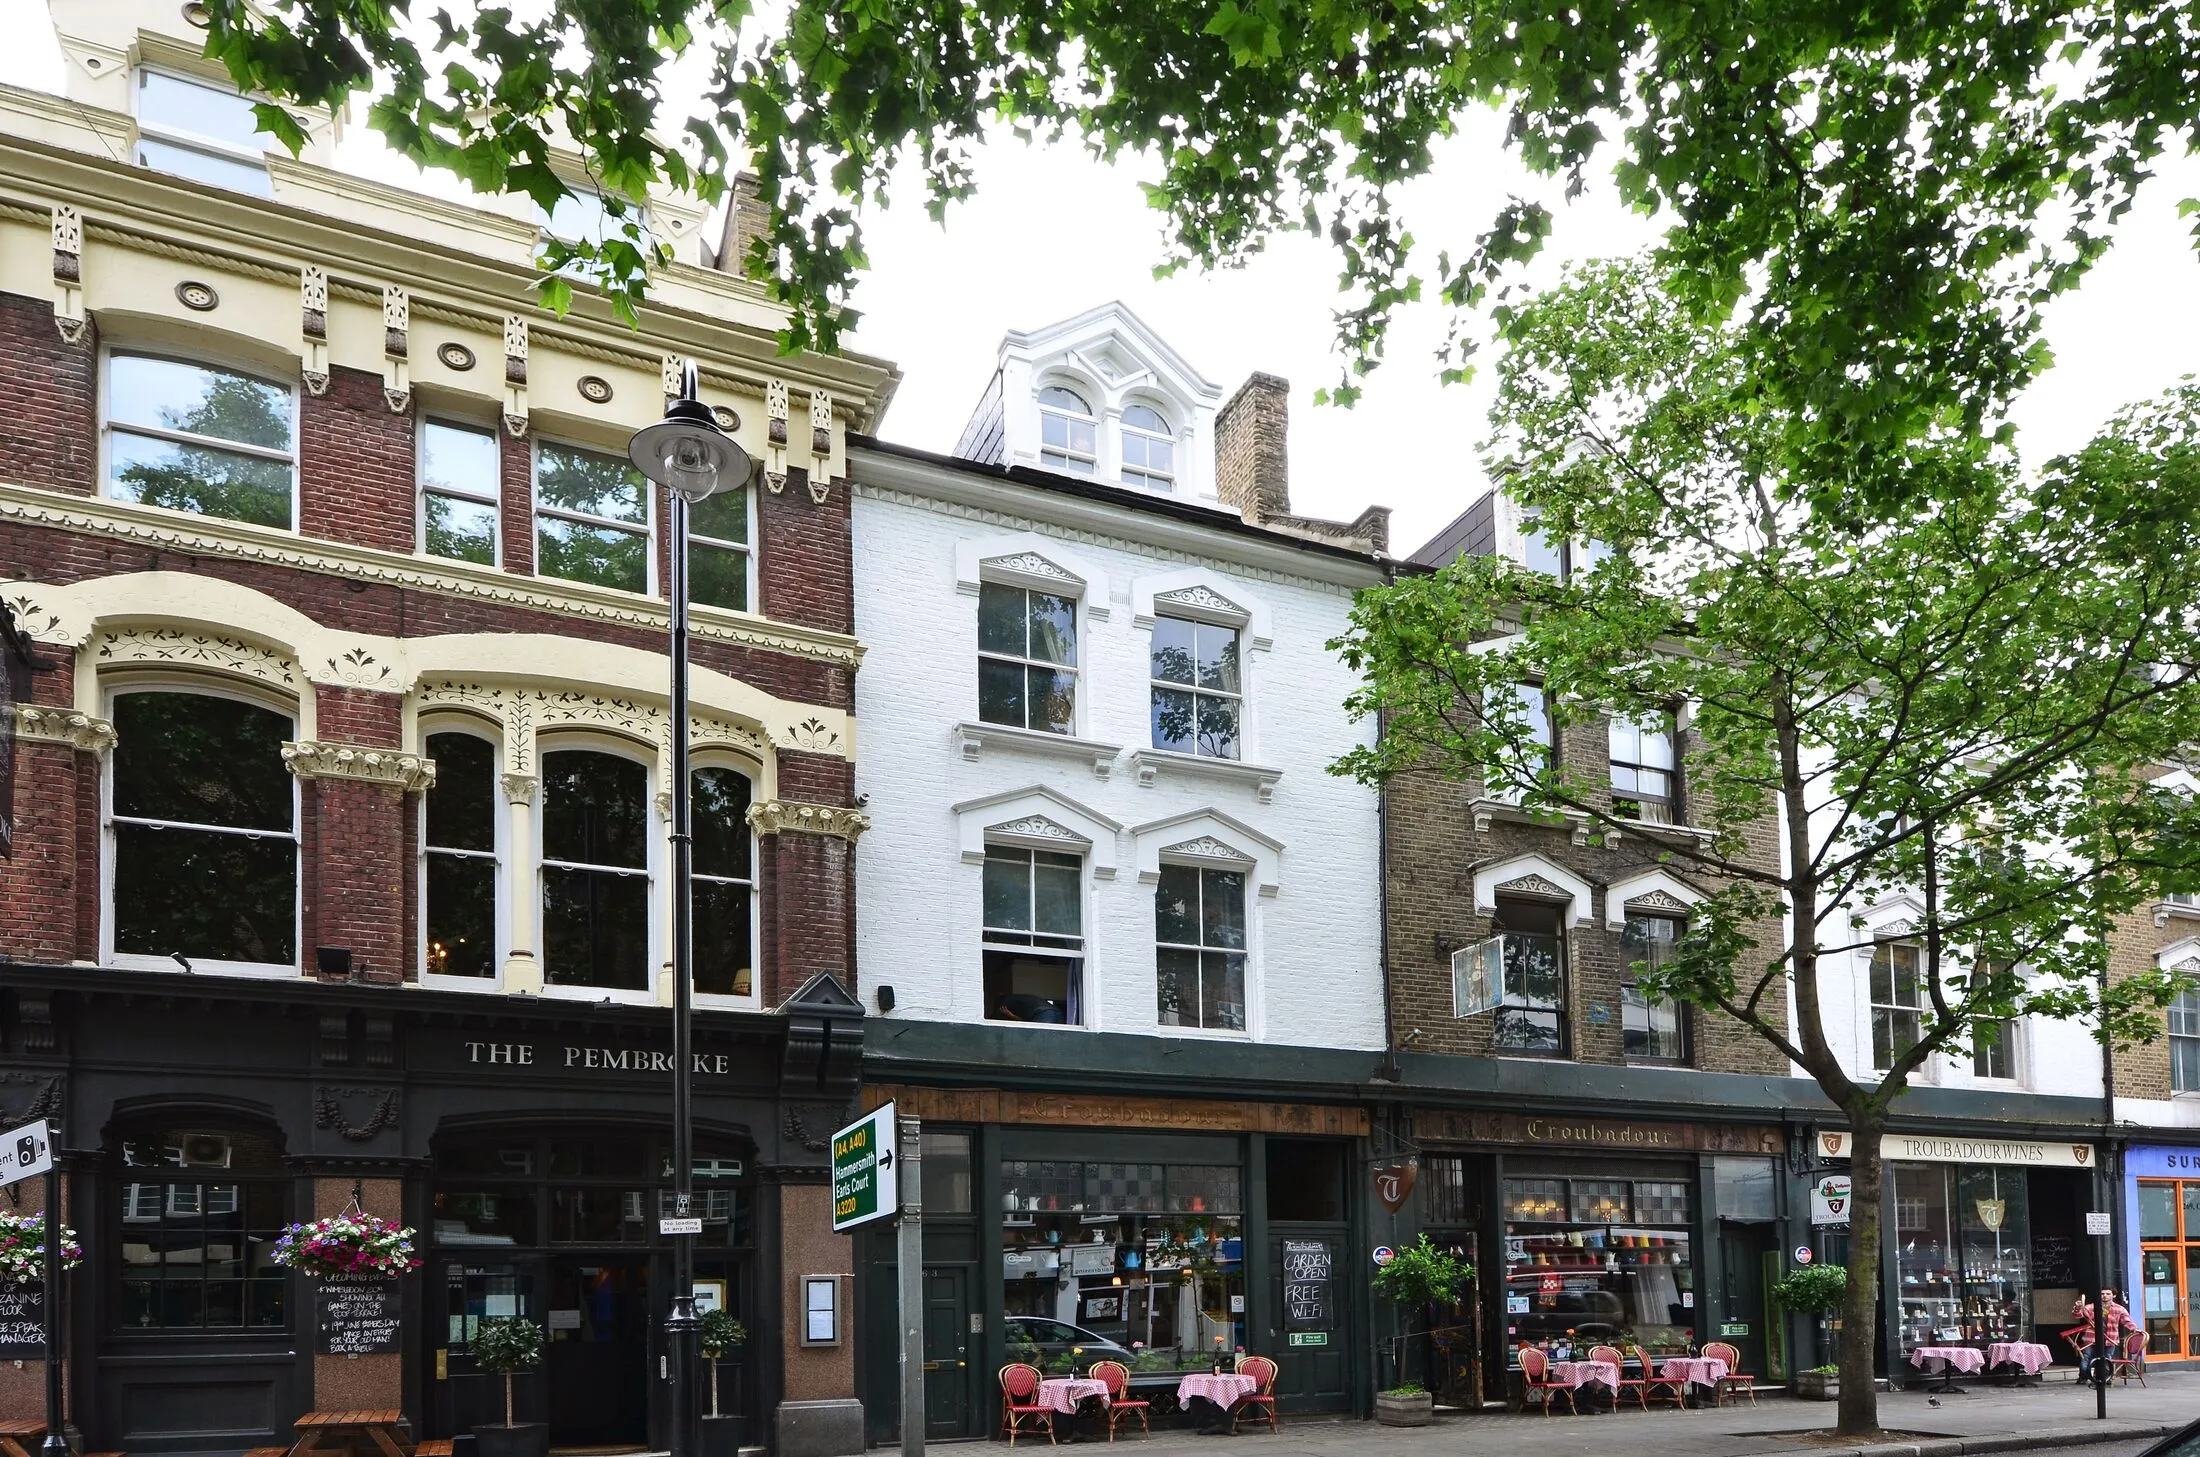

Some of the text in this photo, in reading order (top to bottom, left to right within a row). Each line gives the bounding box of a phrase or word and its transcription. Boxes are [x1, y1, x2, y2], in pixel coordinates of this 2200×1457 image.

[465, 1041, 729, 1075] THE PEMBRKE
[1527, 1120, 1672, 1144] Troubadour
[834, 1128, 866, 1160] (A4, A40)
[1903, 1140, 2044, 1161] TROUBADOUR WINES
[835, 1150, 875, 1181] Hammersmith
[836, 1173, 869, 1199] Earls Court
[836, 1197, 856, 1217] A3220
[1284, 1253, 1331, 1271] GARDEN
[1294, 1267, 1327, 1279] OPEN
[1284, 1284, 1321, 1303] FREE
[328, 1301, 352, 1311] GAMES
[366, 1301, 382, 1309] THE
[9, 1321, 43, 1334] SPEAK
